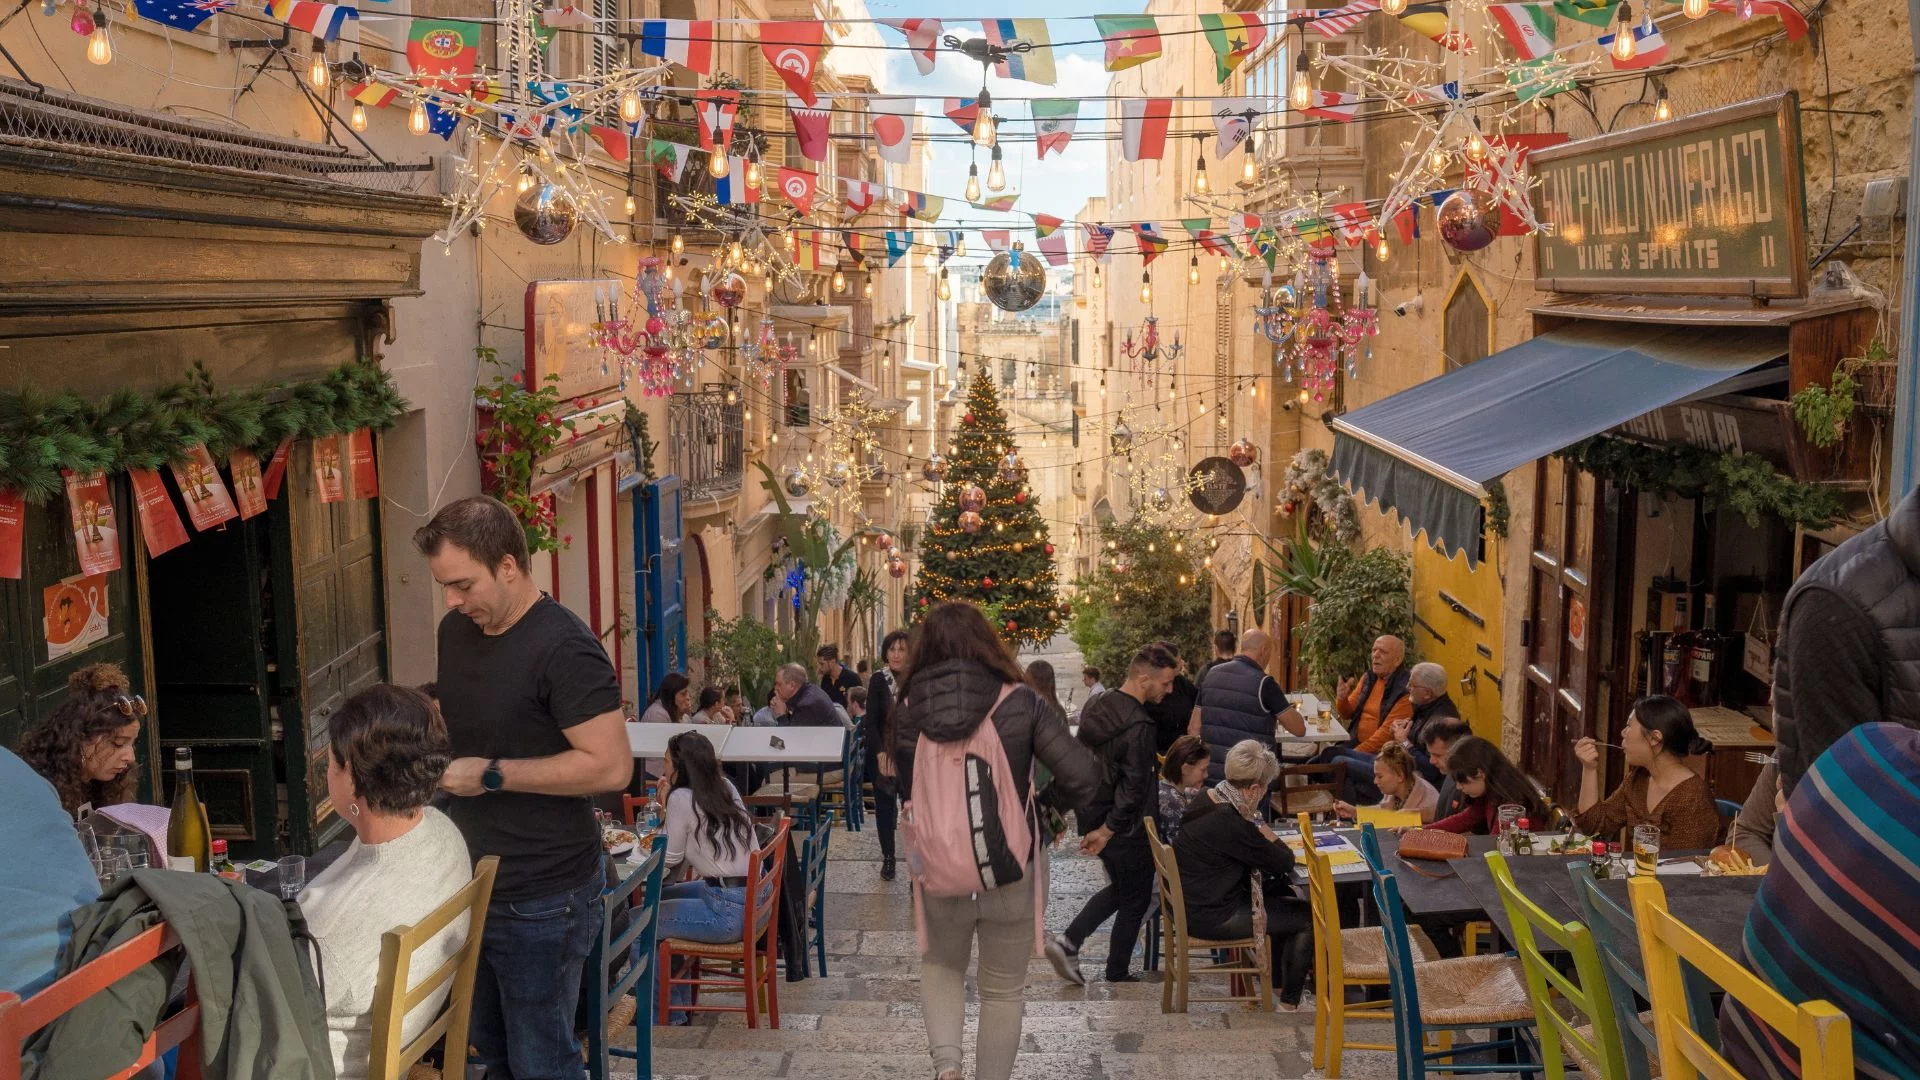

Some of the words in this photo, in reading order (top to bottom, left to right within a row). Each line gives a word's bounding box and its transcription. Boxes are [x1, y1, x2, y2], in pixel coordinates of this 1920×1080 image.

[1541, 167, 1573, 237] SAN
[1576, 156, 1640, 236] PAOLO
[1641, 129, 1773, 233] NAUFRAGO
[1577, 243, 1613, 270] WINE
[1620, 243, 1631, 270] &
[1638, 238, 1720, 270] SPIRITS
